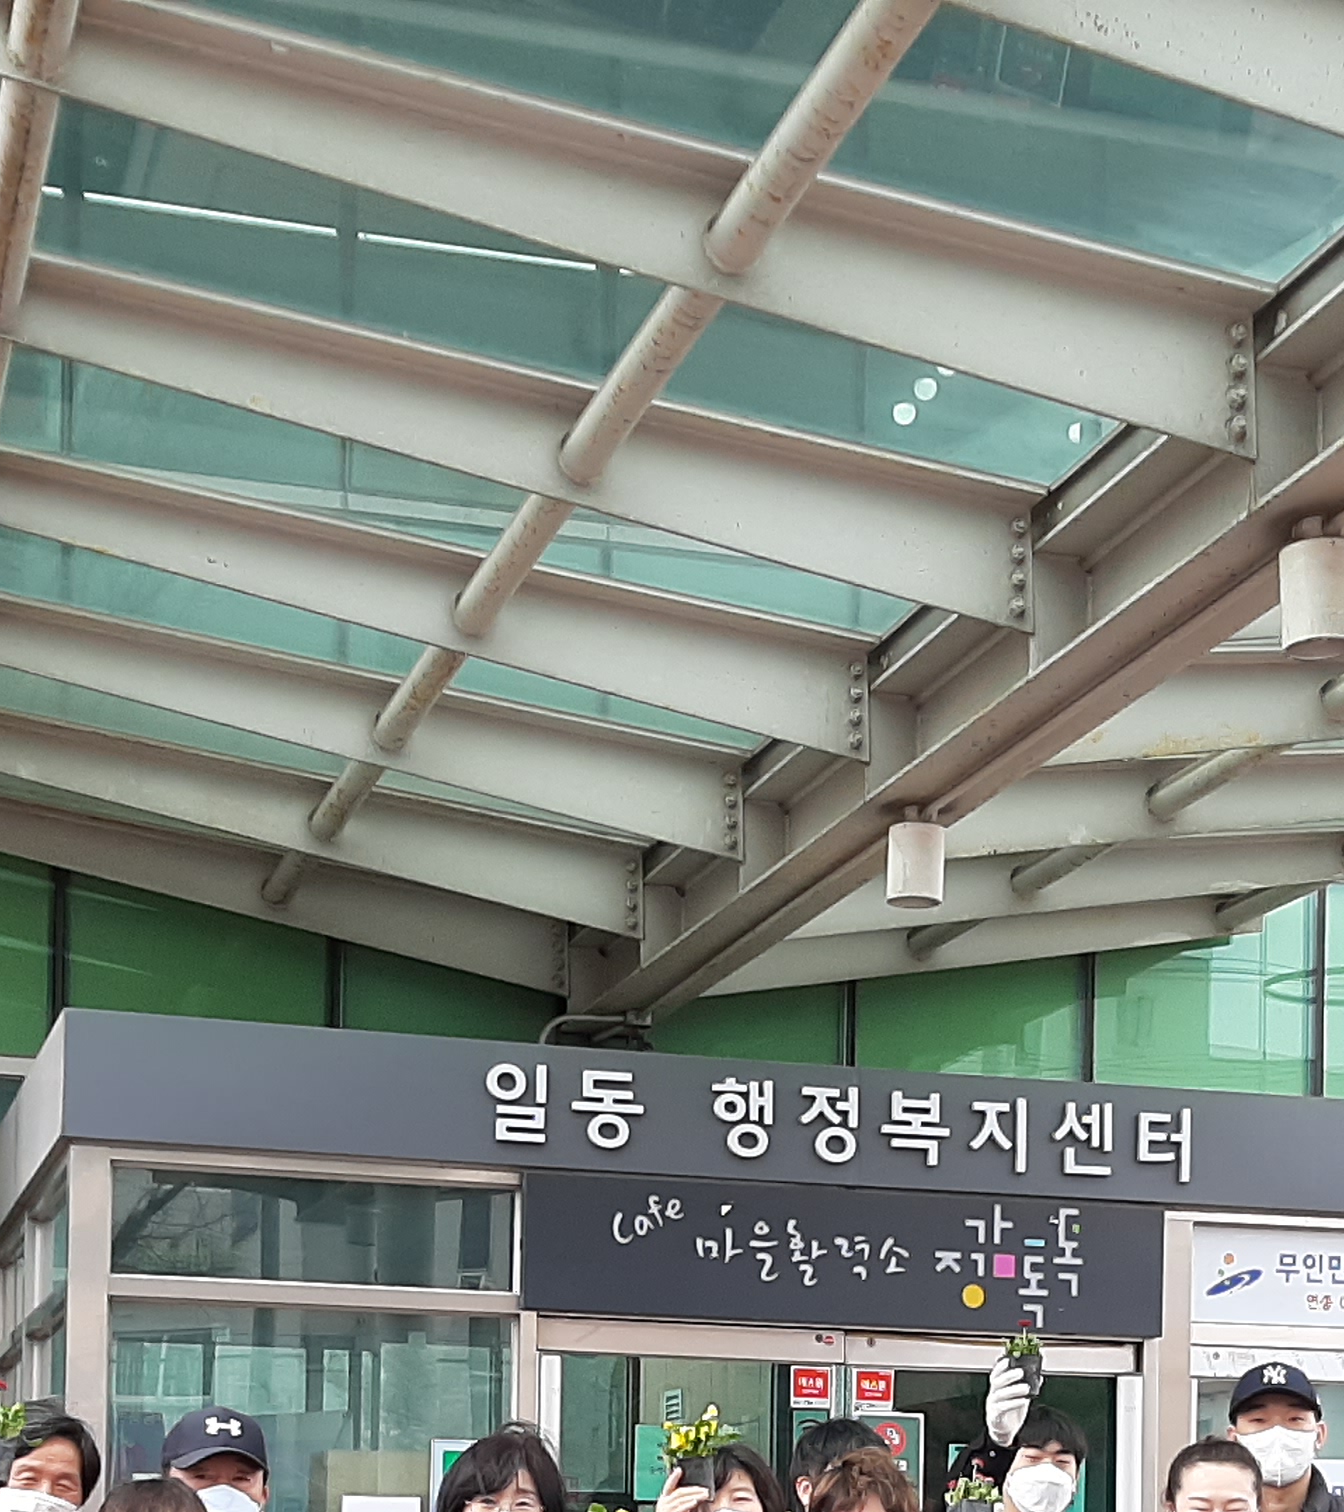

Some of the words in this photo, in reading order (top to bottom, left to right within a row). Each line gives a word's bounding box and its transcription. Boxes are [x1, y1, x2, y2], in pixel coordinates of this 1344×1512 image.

[484, 1063, 645, 1150] 일동
[711, 1077, 1194, 1183] 행정복지센터
[696, 1217, 910, 1286] 마을활력소
